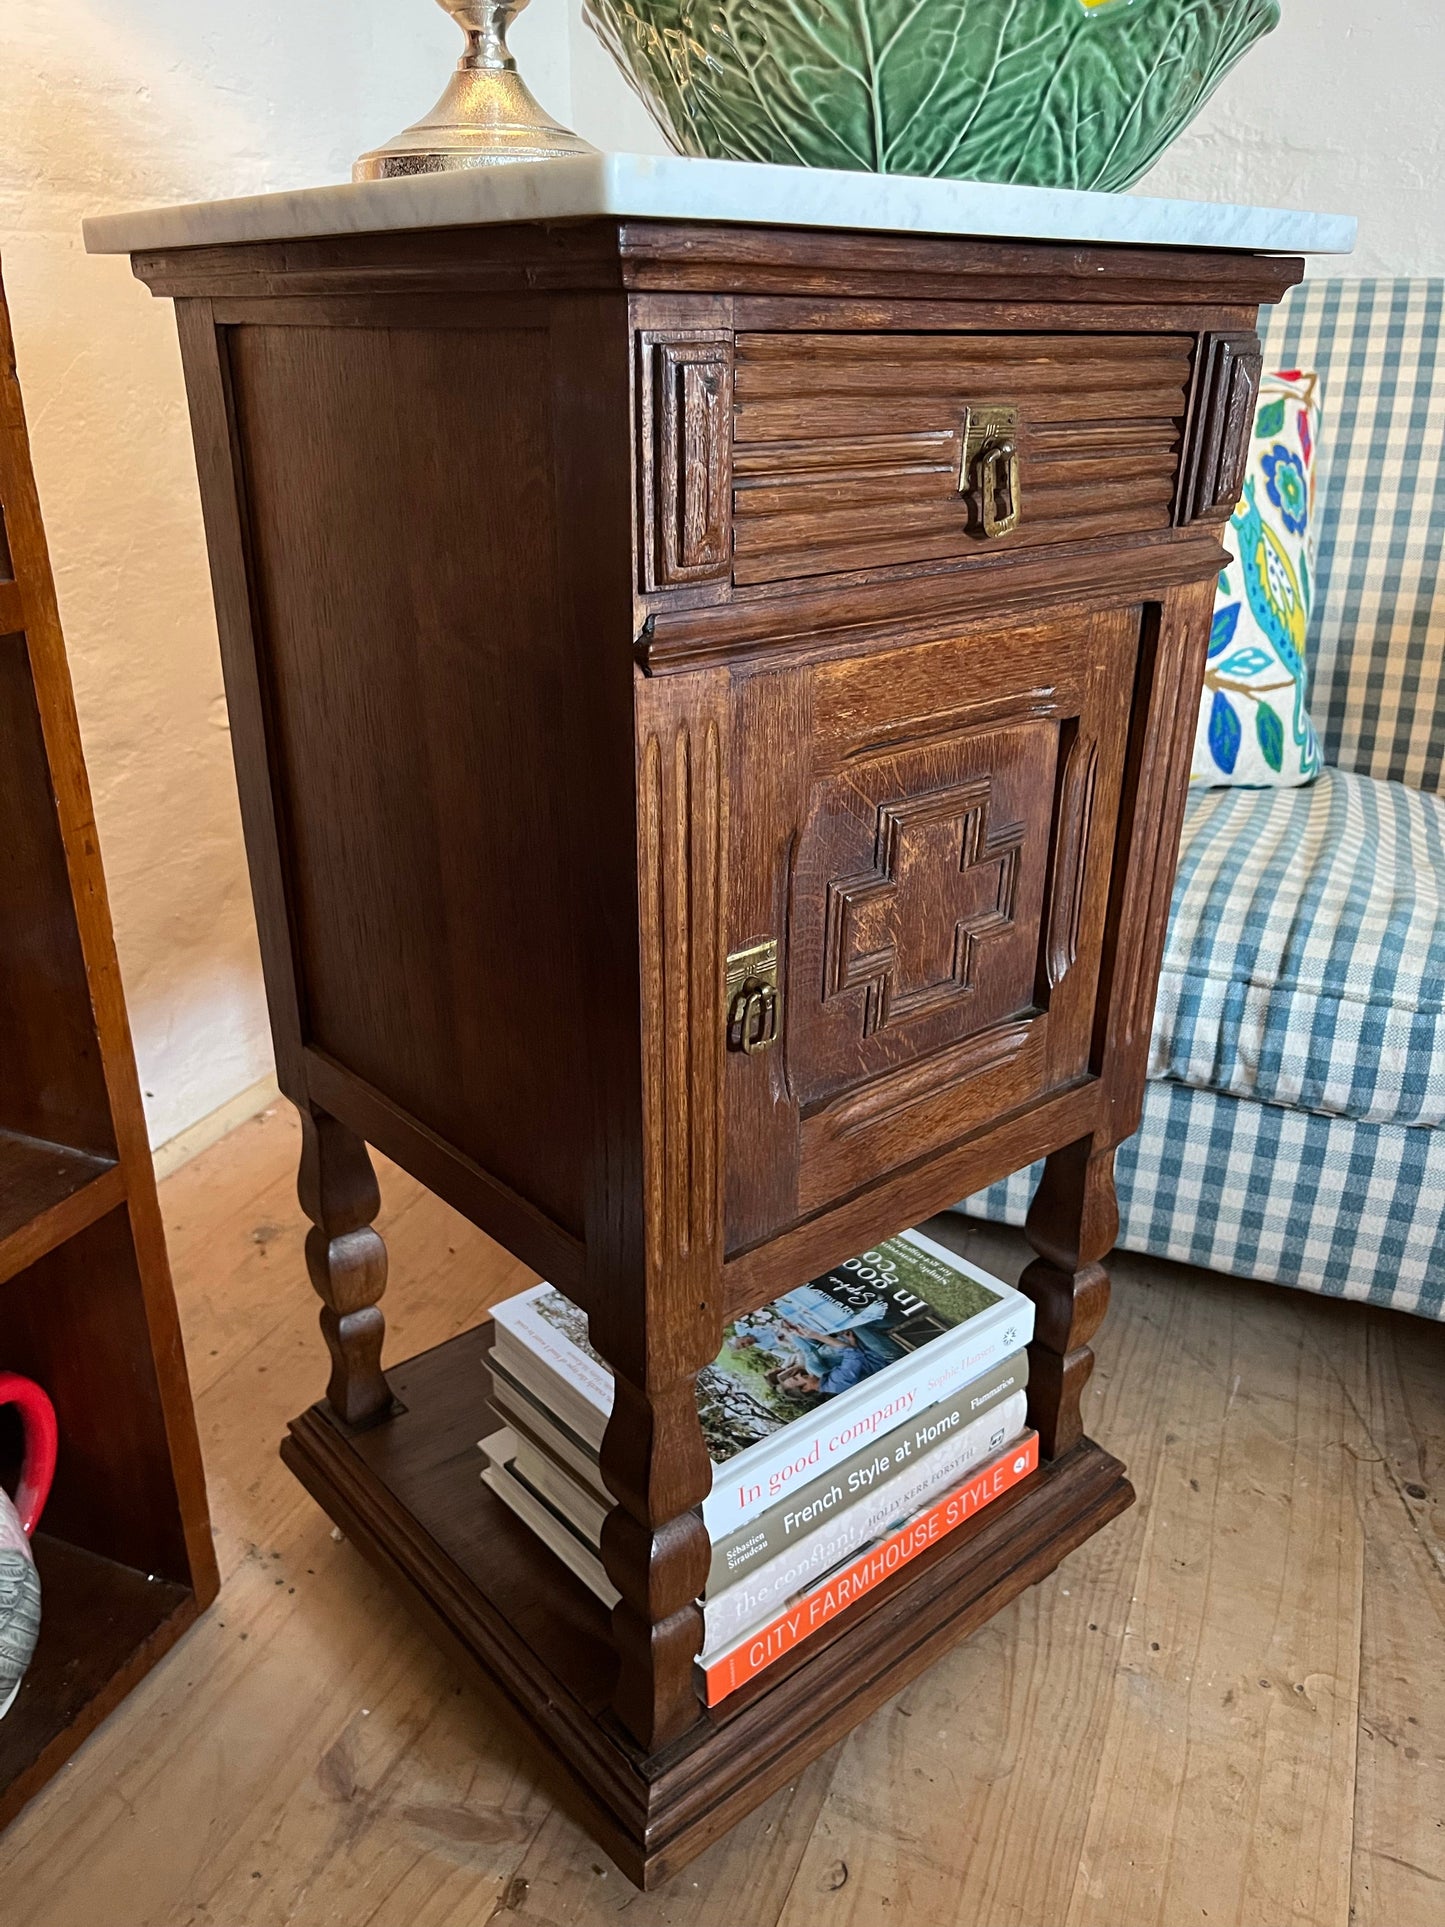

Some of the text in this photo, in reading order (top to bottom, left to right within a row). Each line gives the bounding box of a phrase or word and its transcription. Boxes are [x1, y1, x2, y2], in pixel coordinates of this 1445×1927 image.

[893, 1288, 929, 1317] In
[927, 1344, 996, 1391] Sophie Hansen
[970, 1376, 1015, 1411] Flammarion
[738, 1388, 917, 1509] In good company
[783, 1410, 960, 1535] French Style at Home
[867, 1500, 903, 1527] HOLLY
[903, 1480, 929, 1503] KERR
[726, 1532, 765, 1561] Sébastien
[727, 1540, 768, 1570] Siraudeau
[749, 1613, 801, 1668] CITY
[809, 1513, 940, 1626] FARMHOUSE
[945, 1467, 1005, 1525] STYLE
[735, 1591, 768, 1617] the
[774, 1526, 855, 1591] constant
